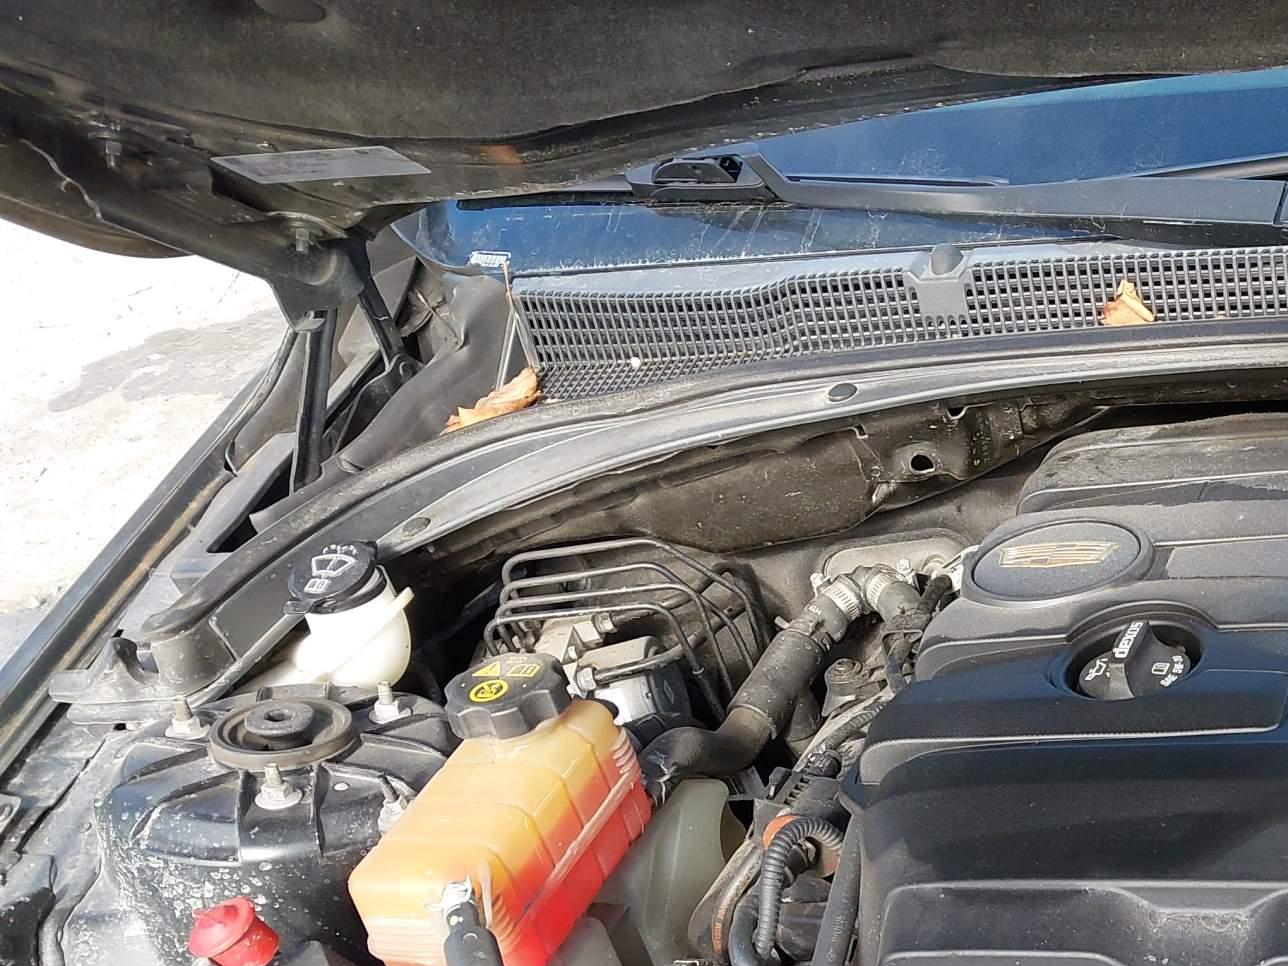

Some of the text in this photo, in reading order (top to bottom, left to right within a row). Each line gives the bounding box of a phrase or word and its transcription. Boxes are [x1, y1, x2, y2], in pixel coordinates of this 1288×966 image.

[1112, 621, 1144, 659] dexos
[1160, 655, 1184, 687] SAE 5W-30
